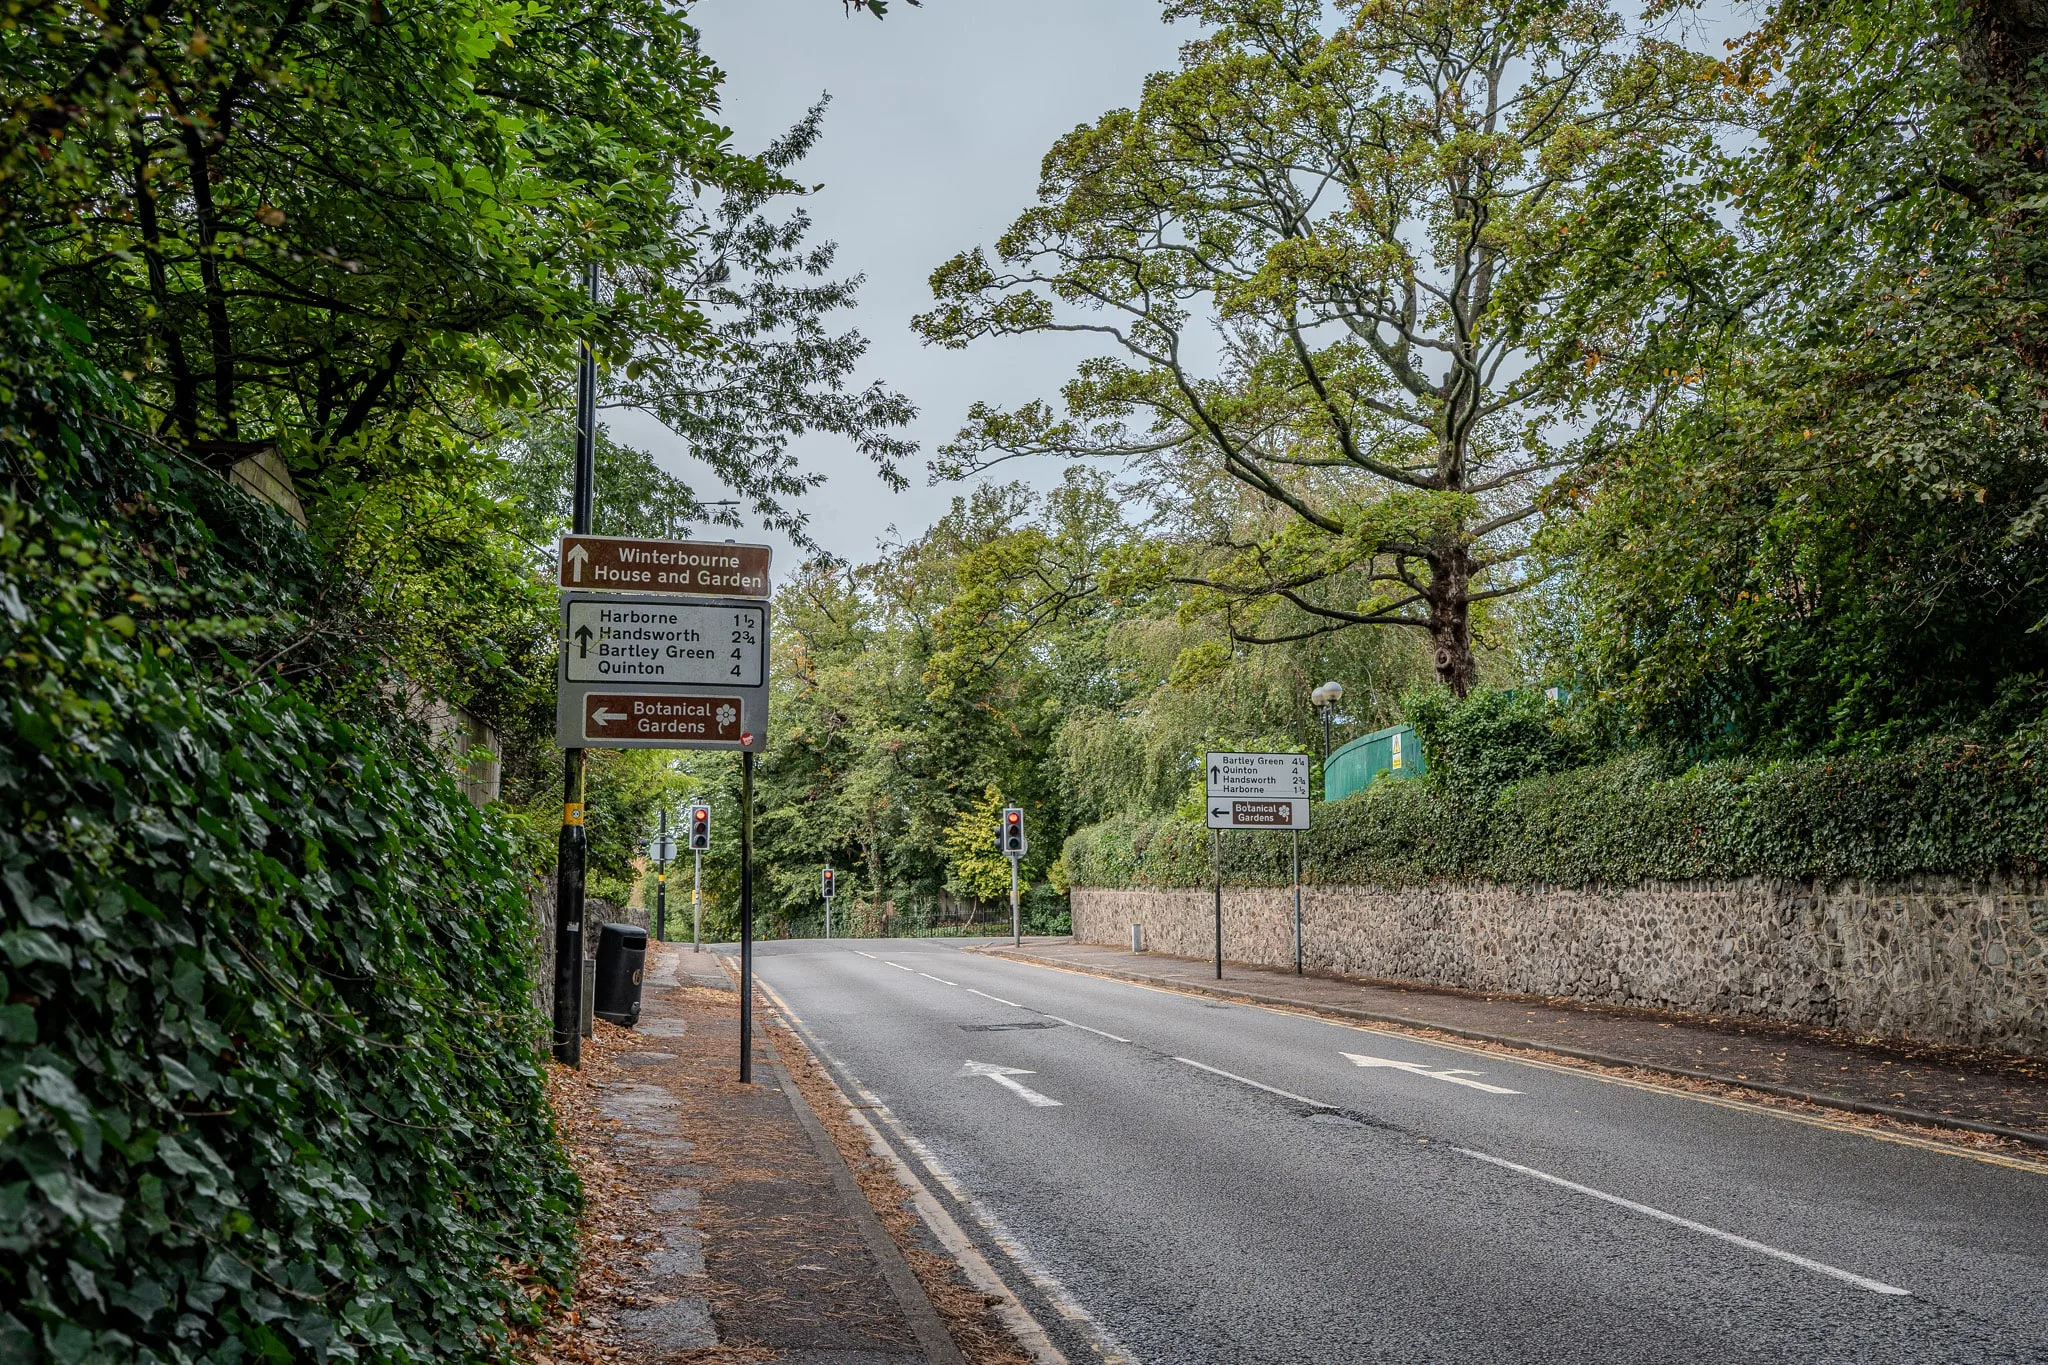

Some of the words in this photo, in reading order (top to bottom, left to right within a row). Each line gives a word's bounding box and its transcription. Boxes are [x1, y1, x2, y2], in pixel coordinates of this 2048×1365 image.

[618, 547, 740, 568] Winterbourne
[595, 565, 651, 582] House
[657, 569, 690, 584] and
[697, 571, 761, 588] Garden
[600, 609, 678, 624] Harborne
[600, 626, 700, 642] Handsworth
[599, 644, 659, 660] Bartley
[665, 646, 715, 659] Green
[730, 648, 741, 660] 4
[598, 660, 665, 675] Quinton
[730, 665, 741, 677] 4
[633, 701, 711, 717] Botanical
[637, 719, 705, 733] Gardens
[1223, 757, 1254, 765] Bartley
[1258, 757, 1284, 765] Green
[1223, 766, 1258, 774] Quinton
[1223, 776, 1276, 784] Handsworth
[1223, 785, 1264, 793] Harborne
[1236, 804, 1276, 812] Botanical
